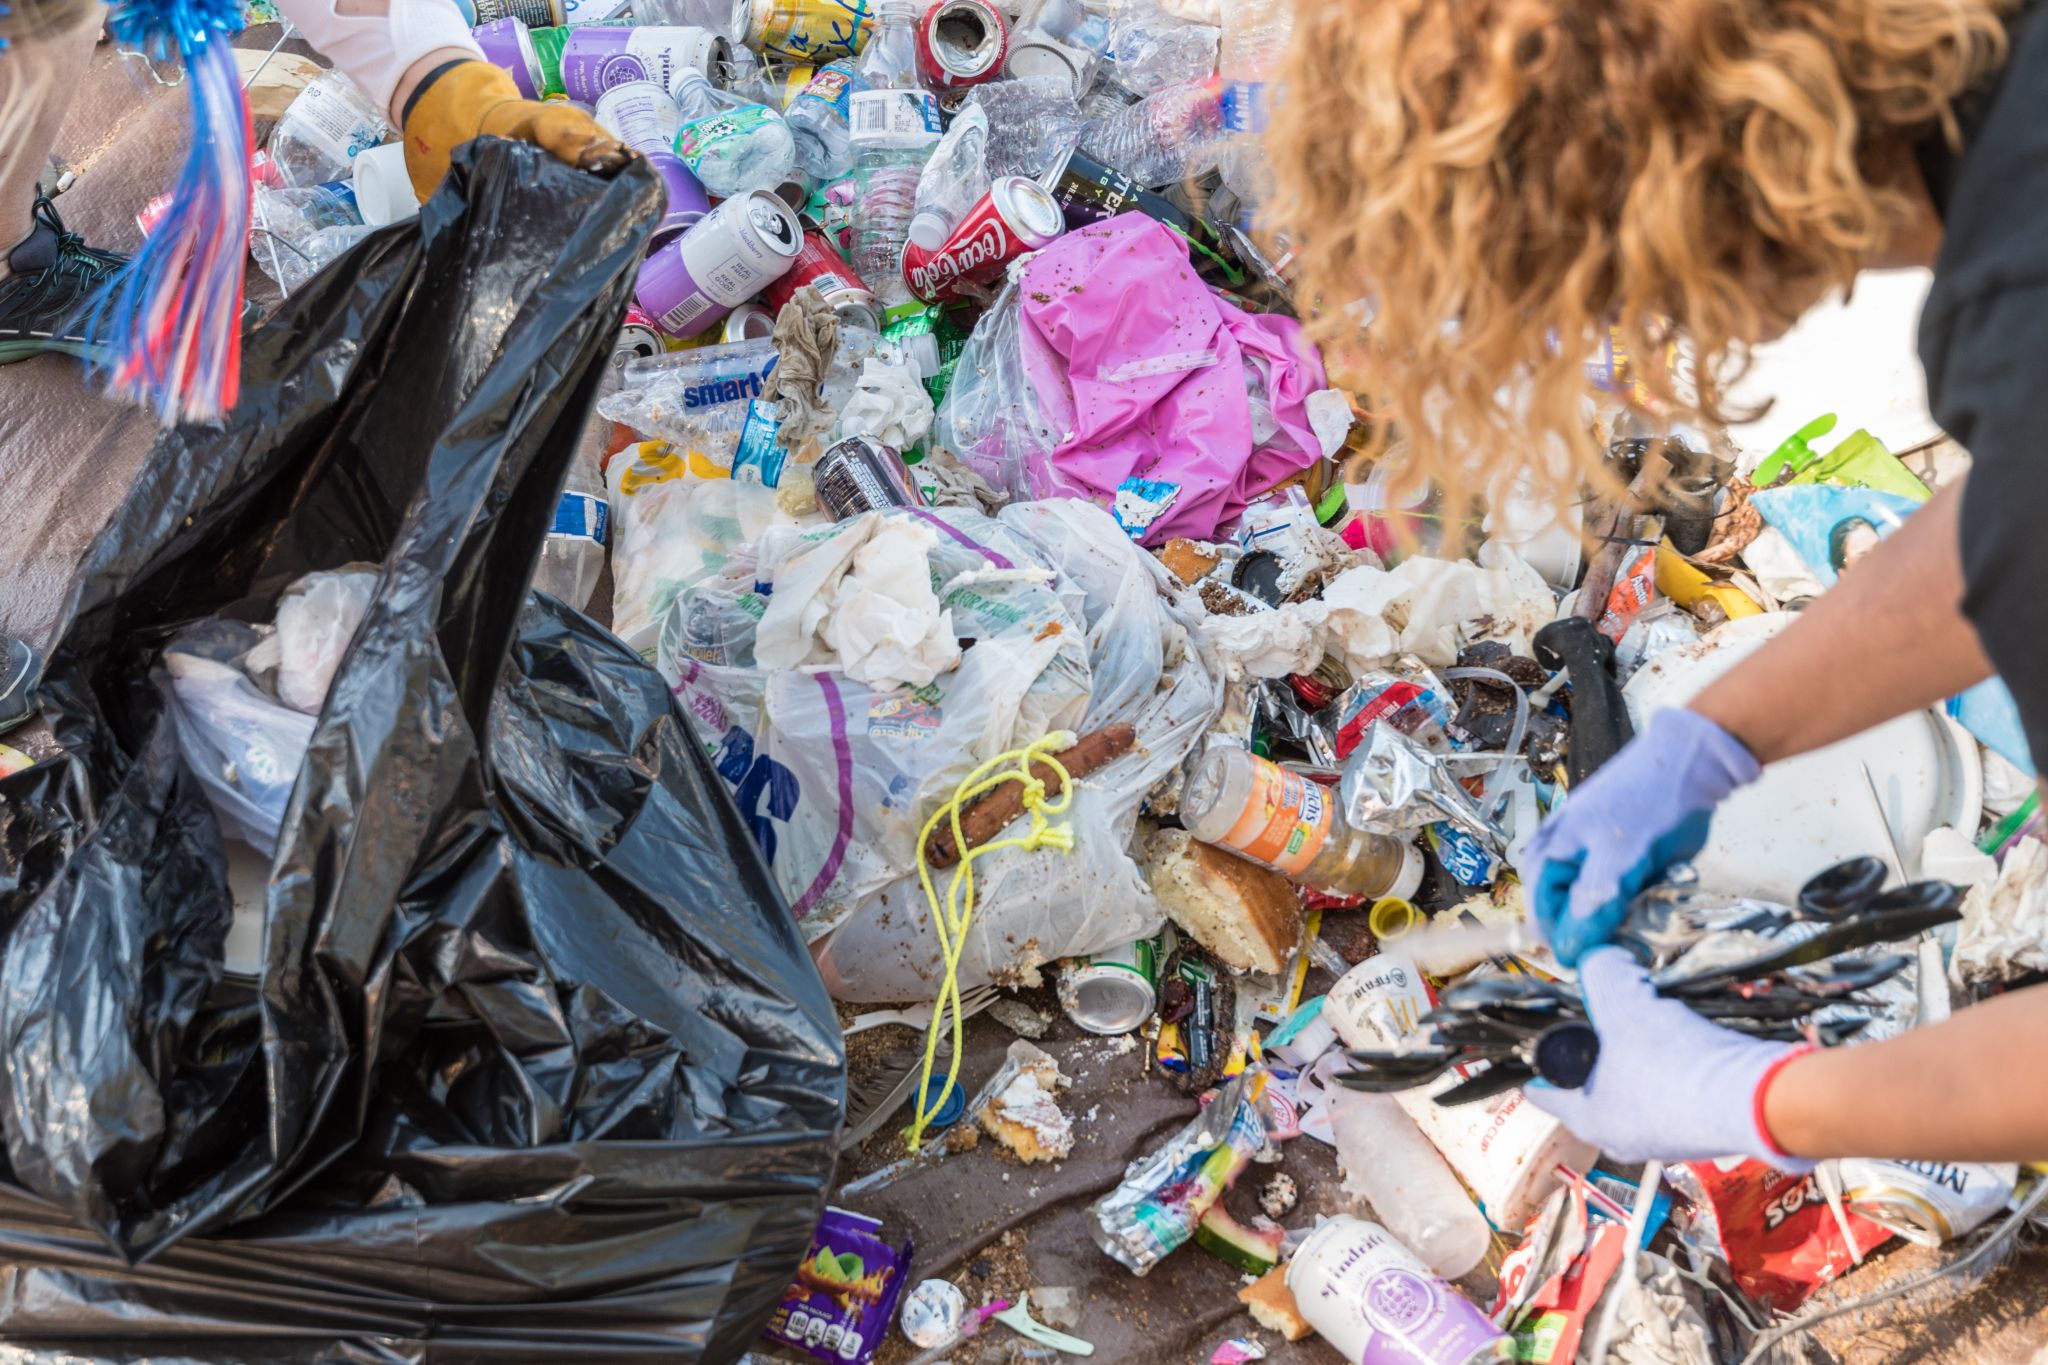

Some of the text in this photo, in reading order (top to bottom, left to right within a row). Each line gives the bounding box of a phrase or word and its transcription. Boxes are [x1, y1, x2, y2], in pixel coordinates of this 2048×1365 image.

[730, 265, 750, 281] FRUIT
[736, 262, 752, 277] REAL
[714, 276, 734, 293] GOOD
[720, 274, 737, 289] REAL
[684, 372, 761, 408] smart
